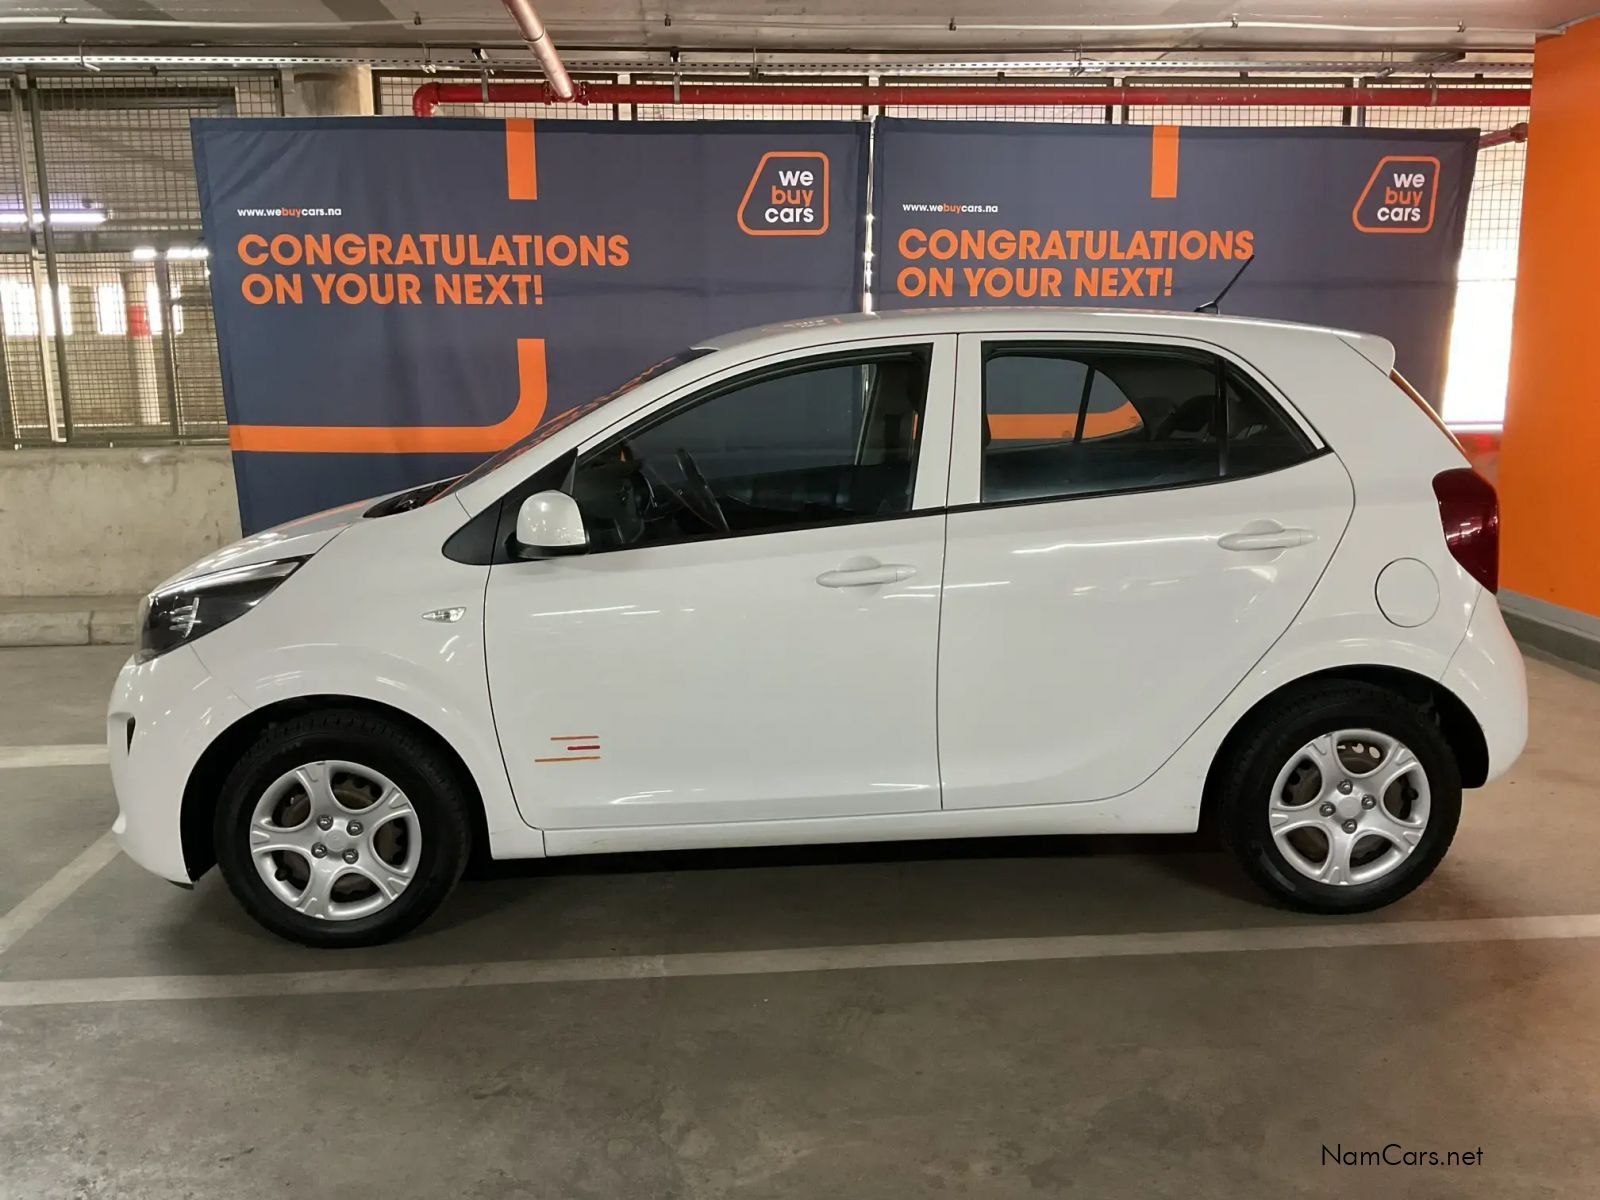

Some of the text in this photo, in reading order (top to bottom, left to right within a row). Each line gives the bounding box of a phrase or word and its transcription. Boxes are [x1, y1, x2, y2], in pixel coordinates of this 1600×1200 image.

[779, 171, 814, 187] we
[1394, 173, 1425, 188] we
[771, 185, 814, 207] buy
[1384, 187, 1423, 207] buy
[237, 207, 342, 219] www.webuycars.na
[764, 207, 814, 223] cars
[902, 203, 999, 215] www.webuycars.na
[1376, 206, 1421, 222] cars
[238, 233, 629, 266] CONGRATULATIONS
[897, 228, 1254, 261] CONGRATULATIONS
[241, 273, 544, 305] ON YOUR NEXT!
[896, 266, 1173, 298] ON YOUR NEXT!
